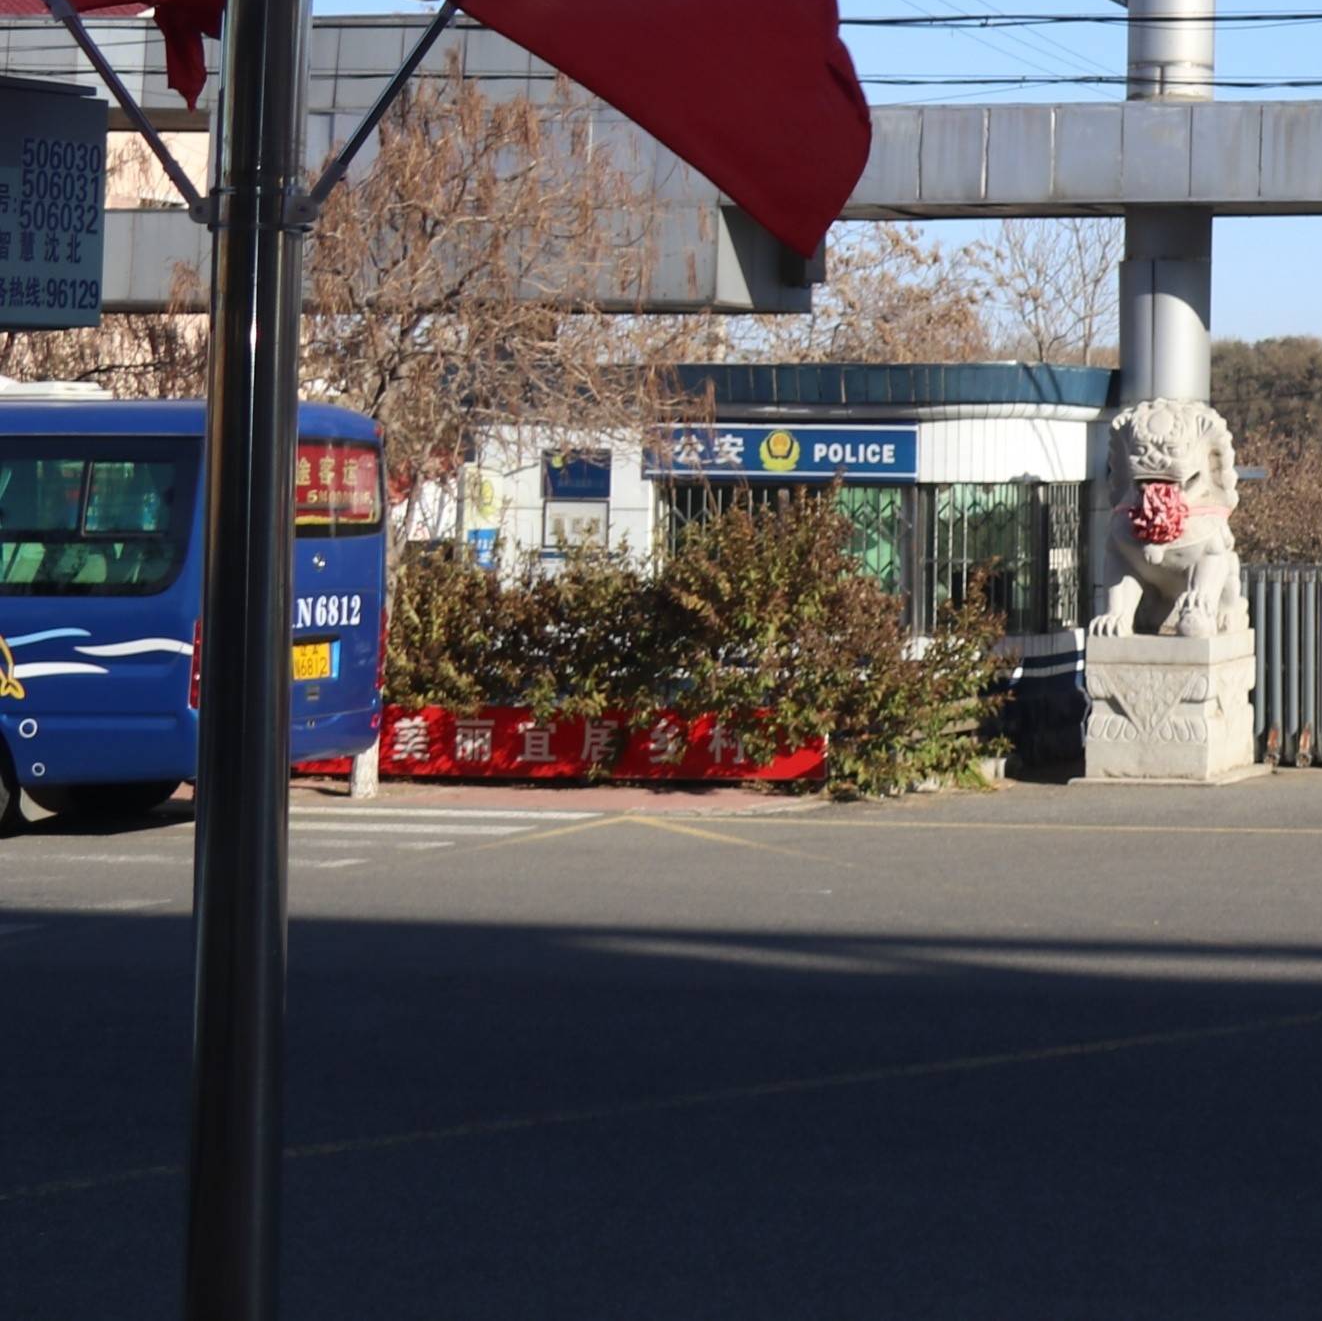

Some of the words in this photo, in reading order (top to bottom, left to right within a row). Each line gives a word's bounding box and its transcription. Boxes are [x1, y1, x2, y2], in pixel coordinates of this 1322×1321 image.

[23, 138, 100, 173] 506030
[22, 168, 99, 205] 506031
[19, 199, 98, 235] 506032
[674, 434, 744, 464] 公安
[813, 443, 896, 464] POLICE
[292, 594, 361, 629] N6812
[391, 716, 746, 763] 美丽宜居乡村
